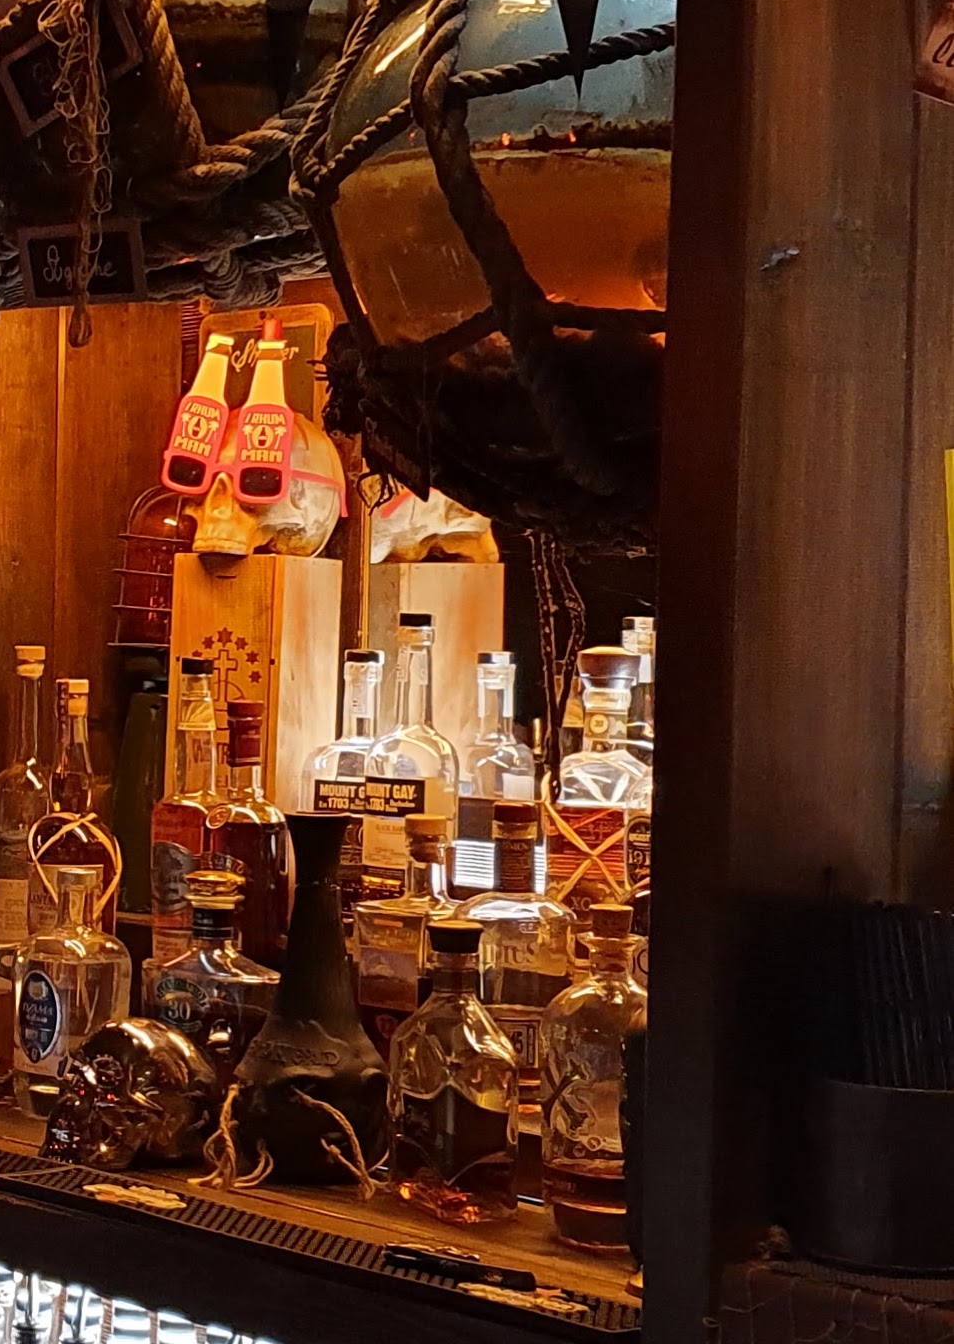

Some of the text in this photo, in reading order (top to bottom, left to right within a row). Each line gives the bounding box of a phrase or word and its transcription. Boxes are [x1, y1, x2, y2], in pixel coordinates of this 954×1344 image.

[189, 402, 221, 421] RHUM
[250, 413, 286, 425] RHUM
[173, 435, 212, 457] MAN
[240, 449, 283, 463] MAN
[319, 783, 357, 798] MOUNT
[392, 784, 416, 799] GAY
